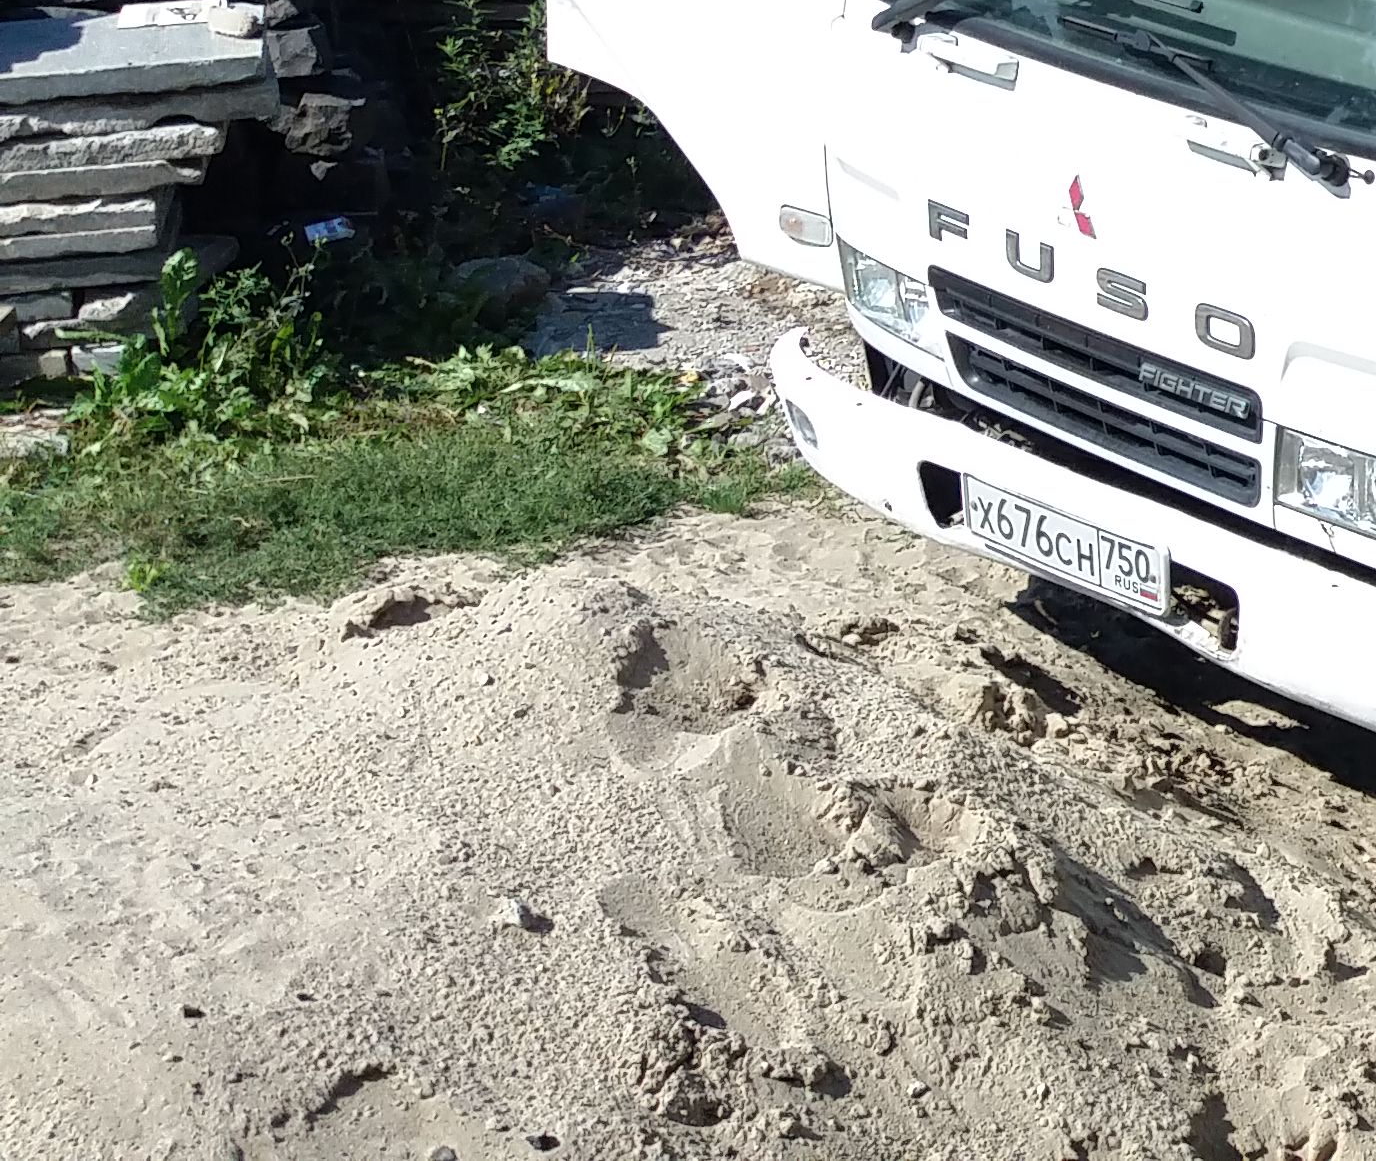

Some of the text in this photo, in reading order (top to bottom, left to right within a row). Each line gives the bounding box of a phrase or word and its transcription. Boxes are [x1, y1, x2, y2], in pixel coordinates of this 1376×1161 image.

[928, 199, 1256, 360] FUSO
[1139, 362, 1251, 420] FIGHTER
[1101, 535, 1150, 584] 750
[1114, 574, 1139, 594] RUS
